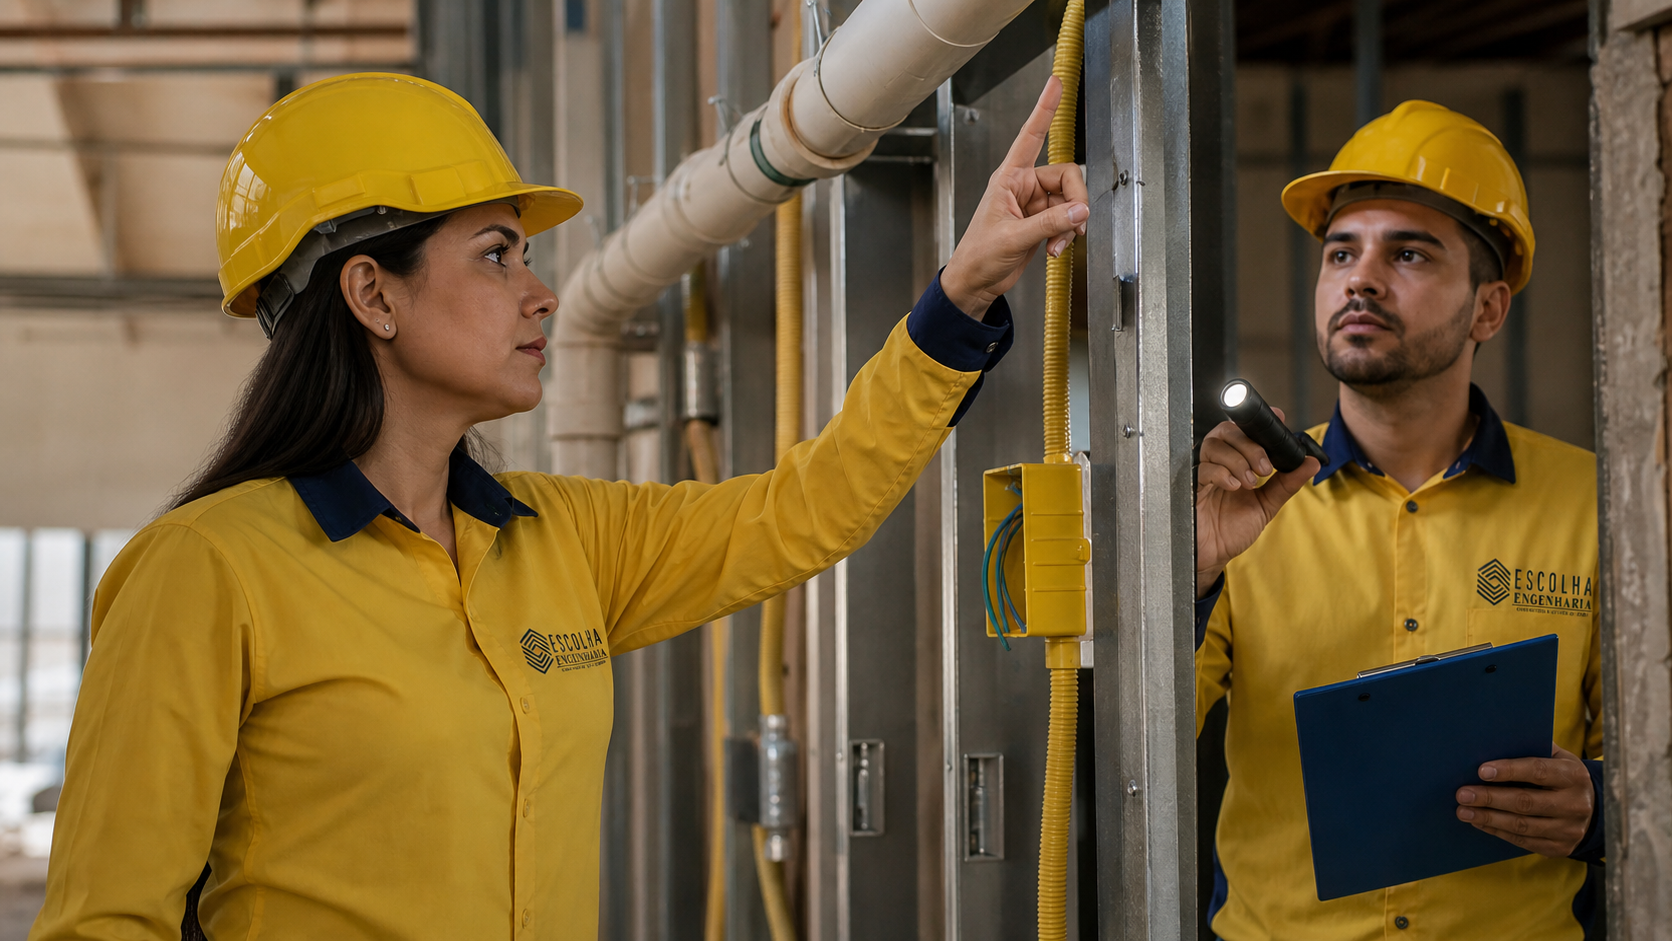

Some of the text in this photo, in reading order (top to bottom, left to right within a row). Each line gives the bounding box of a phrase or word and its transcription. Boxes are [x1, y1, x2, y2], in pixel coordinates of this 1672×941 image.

[1514, 568, 1592, 597] ESCOLHA
[1513, 592, 1592, 610] ENGENHARIA
[547, 628, 603, 653] ESCOLHA
